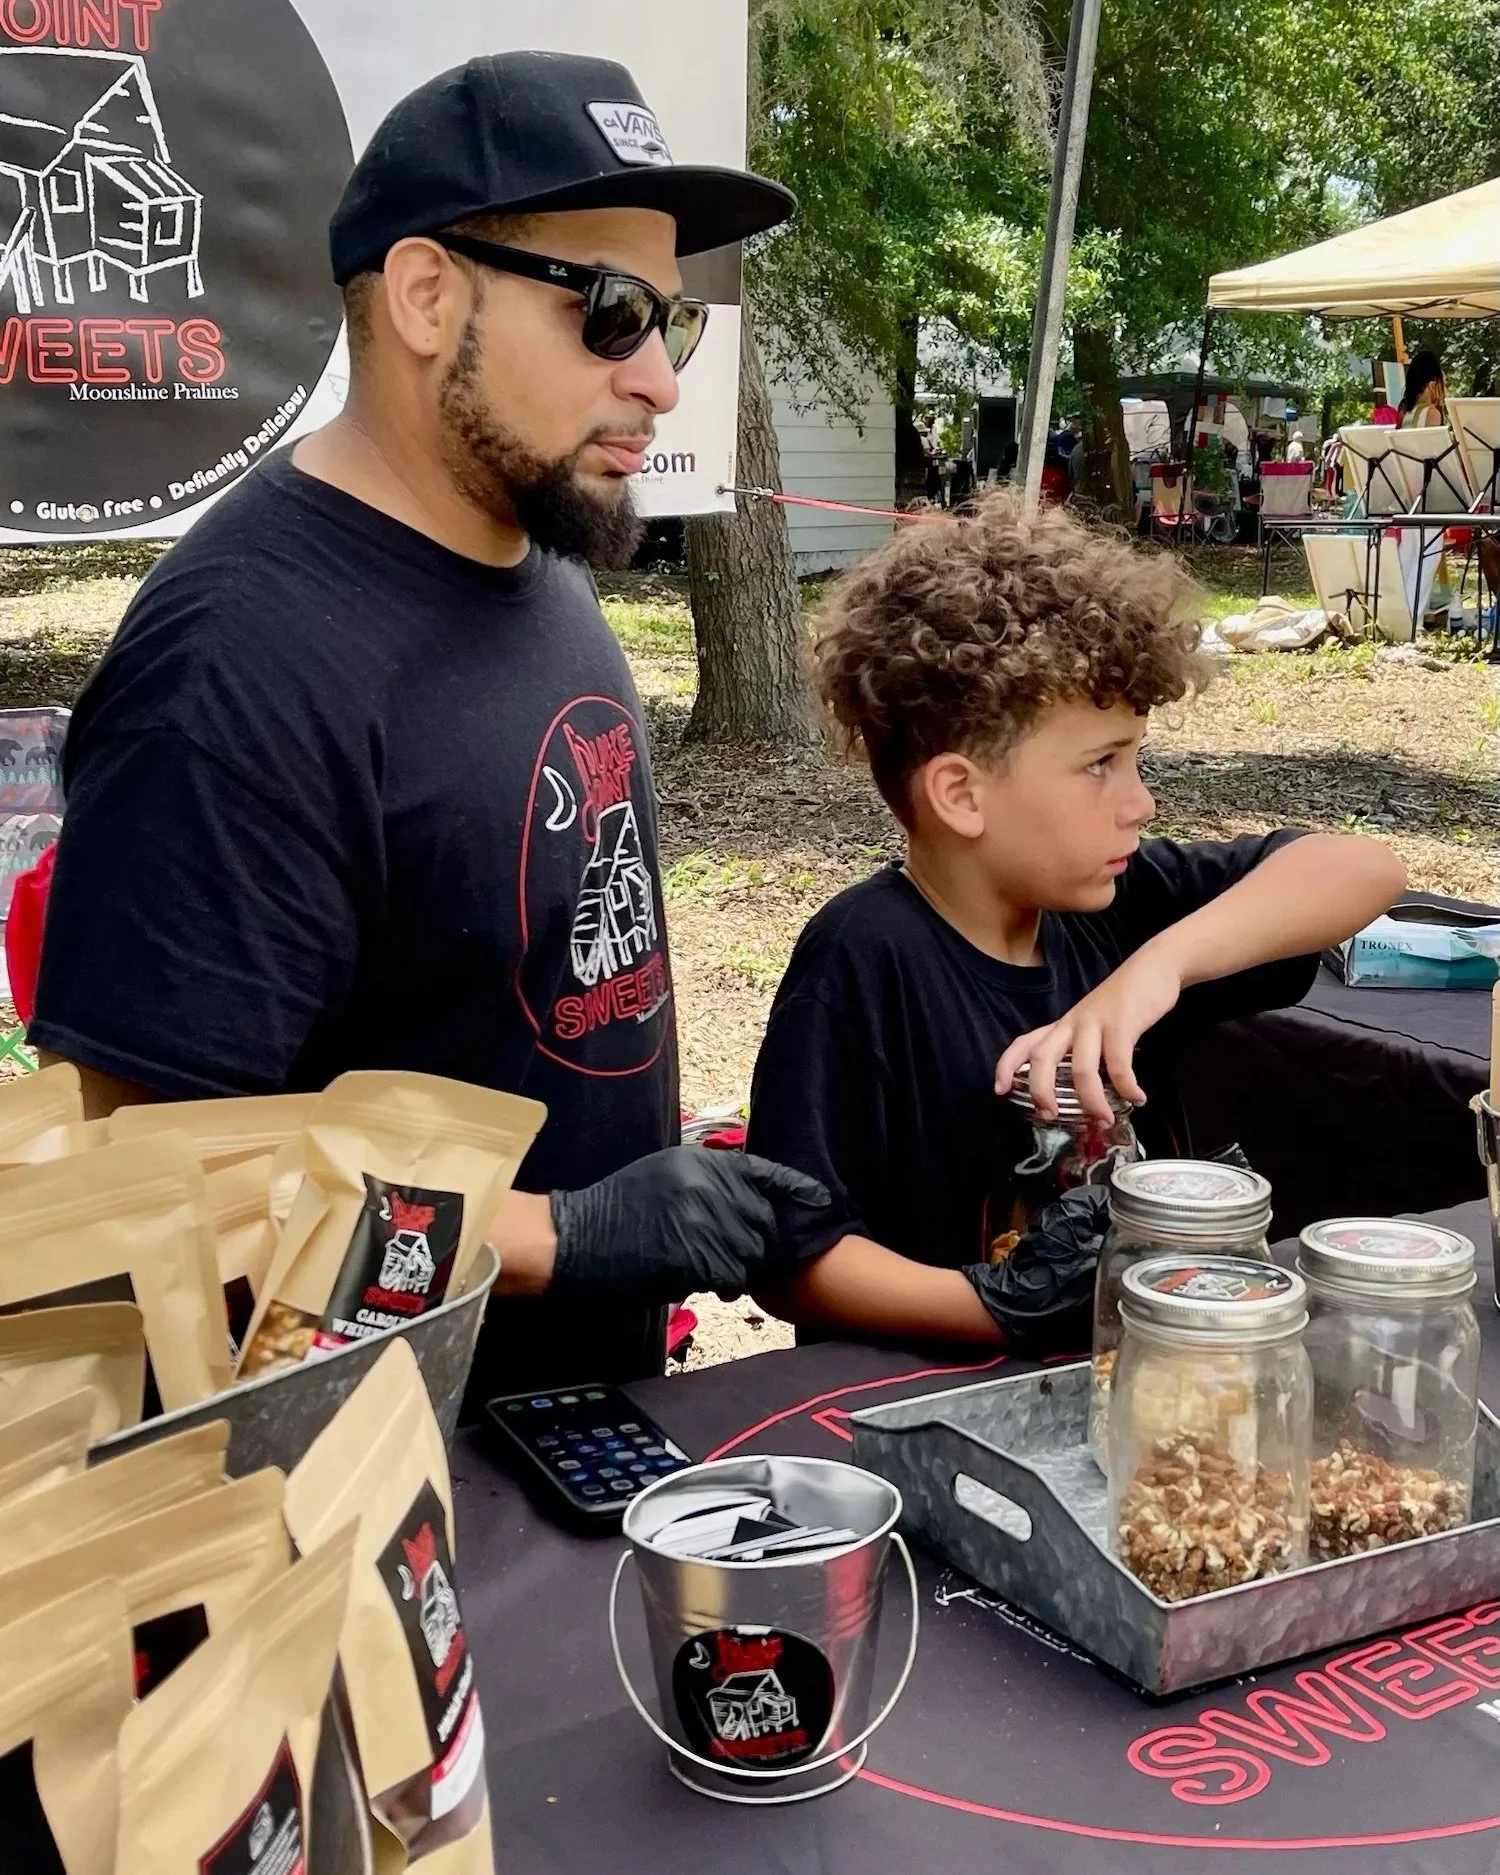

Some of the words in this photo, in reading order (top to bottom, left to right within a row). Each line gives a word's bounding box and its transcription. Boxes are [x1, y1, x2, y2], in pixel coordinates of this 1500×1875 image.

[614, 110, 665, 145] VANS
[69, 382, 168, 401] Moonshine
[173, 383, 239, 401] Pralines
[168, 449, 249, 501] Defiantly
[243, 384, 307, 455] Delicious
[1360, 940, 1413, 951] TRONEX
